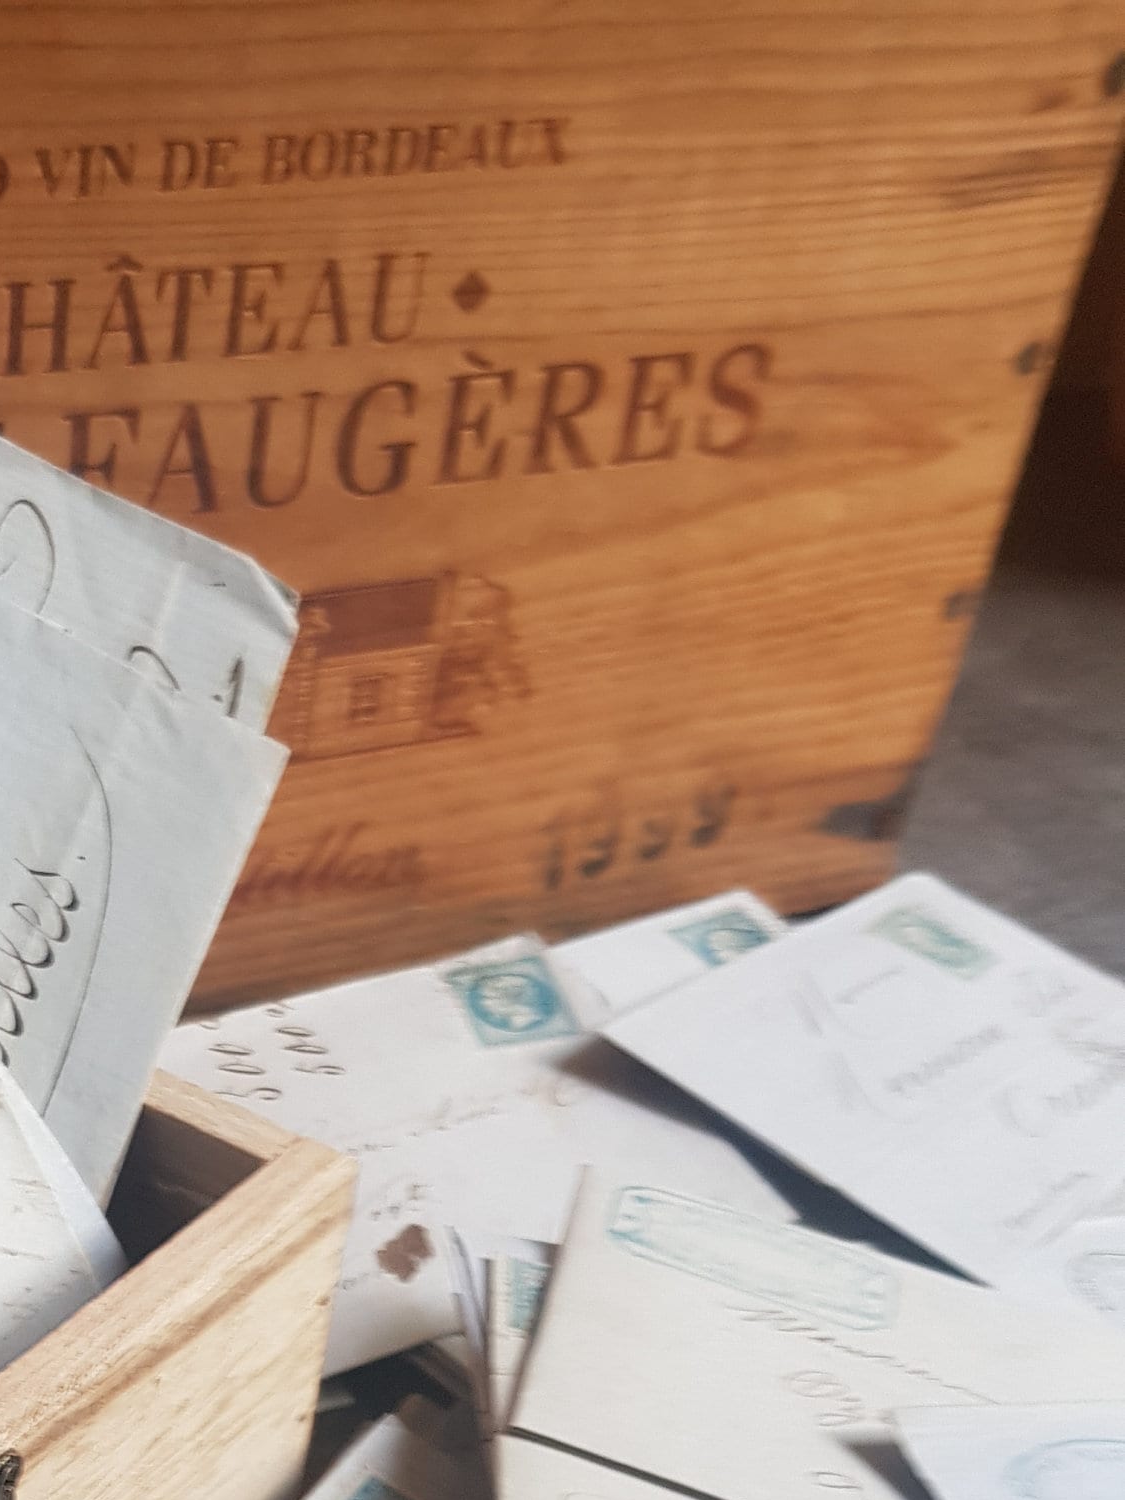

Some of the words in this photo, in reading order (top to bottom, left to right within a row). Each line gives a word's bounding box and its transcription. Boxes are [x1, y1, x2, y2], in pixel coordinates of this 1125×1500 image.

[35, 143, 138, 200] VIN
[159, 136, 242, 195] DE
[264, 116, 573, 185] BORDEAUX
[65, 342, 777, 517] FAUGÈRES
